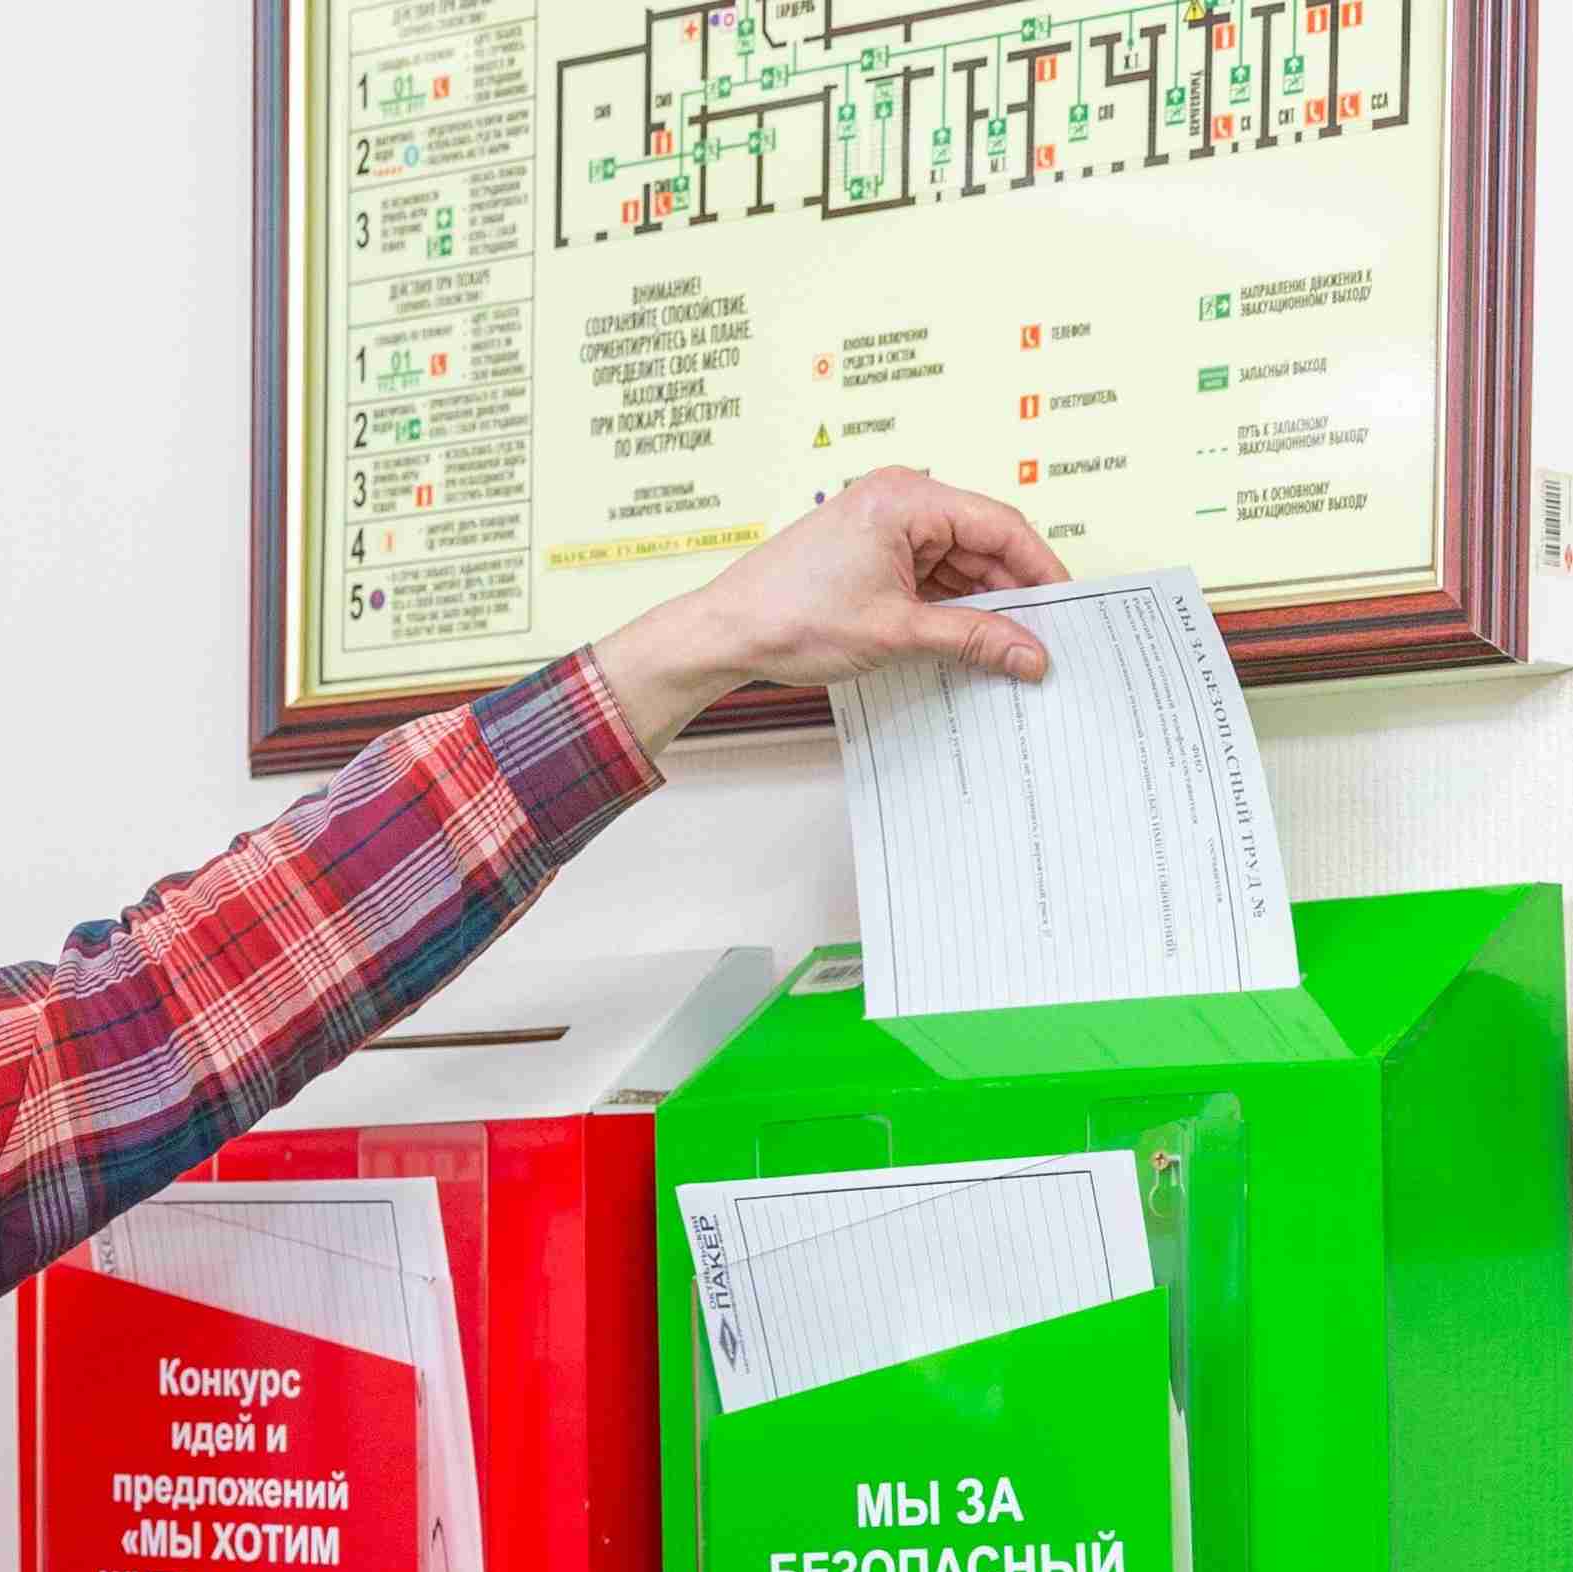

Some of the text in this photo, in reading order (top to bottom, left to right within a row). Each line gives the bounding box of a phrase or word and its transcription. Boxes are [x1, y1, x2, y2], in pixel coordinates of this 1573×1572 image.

[357, 72, 368, 109] 1
[356, 139, 370, 175] 2
[356, 212, 370, 249] 3
[356, 346, 366, 383] 1
[354, 412, 367, 448] 2
[353, 472, 366, 508] 3
[351, 529, 365, 564] 4
[350, 585, 364, 620] 5
[699, 1215, 731, 1310] ПАКЕР
[158, 1356, 301, 1407] Конкурс
[171, 1412, 288, 1457] идей и
[112, 1470, 349, 1512] предложений
[856, 1476, 1025, 1528] МЫ ЗА
[121, 1518, 340, 1565] «МЫ ХОТИМ
